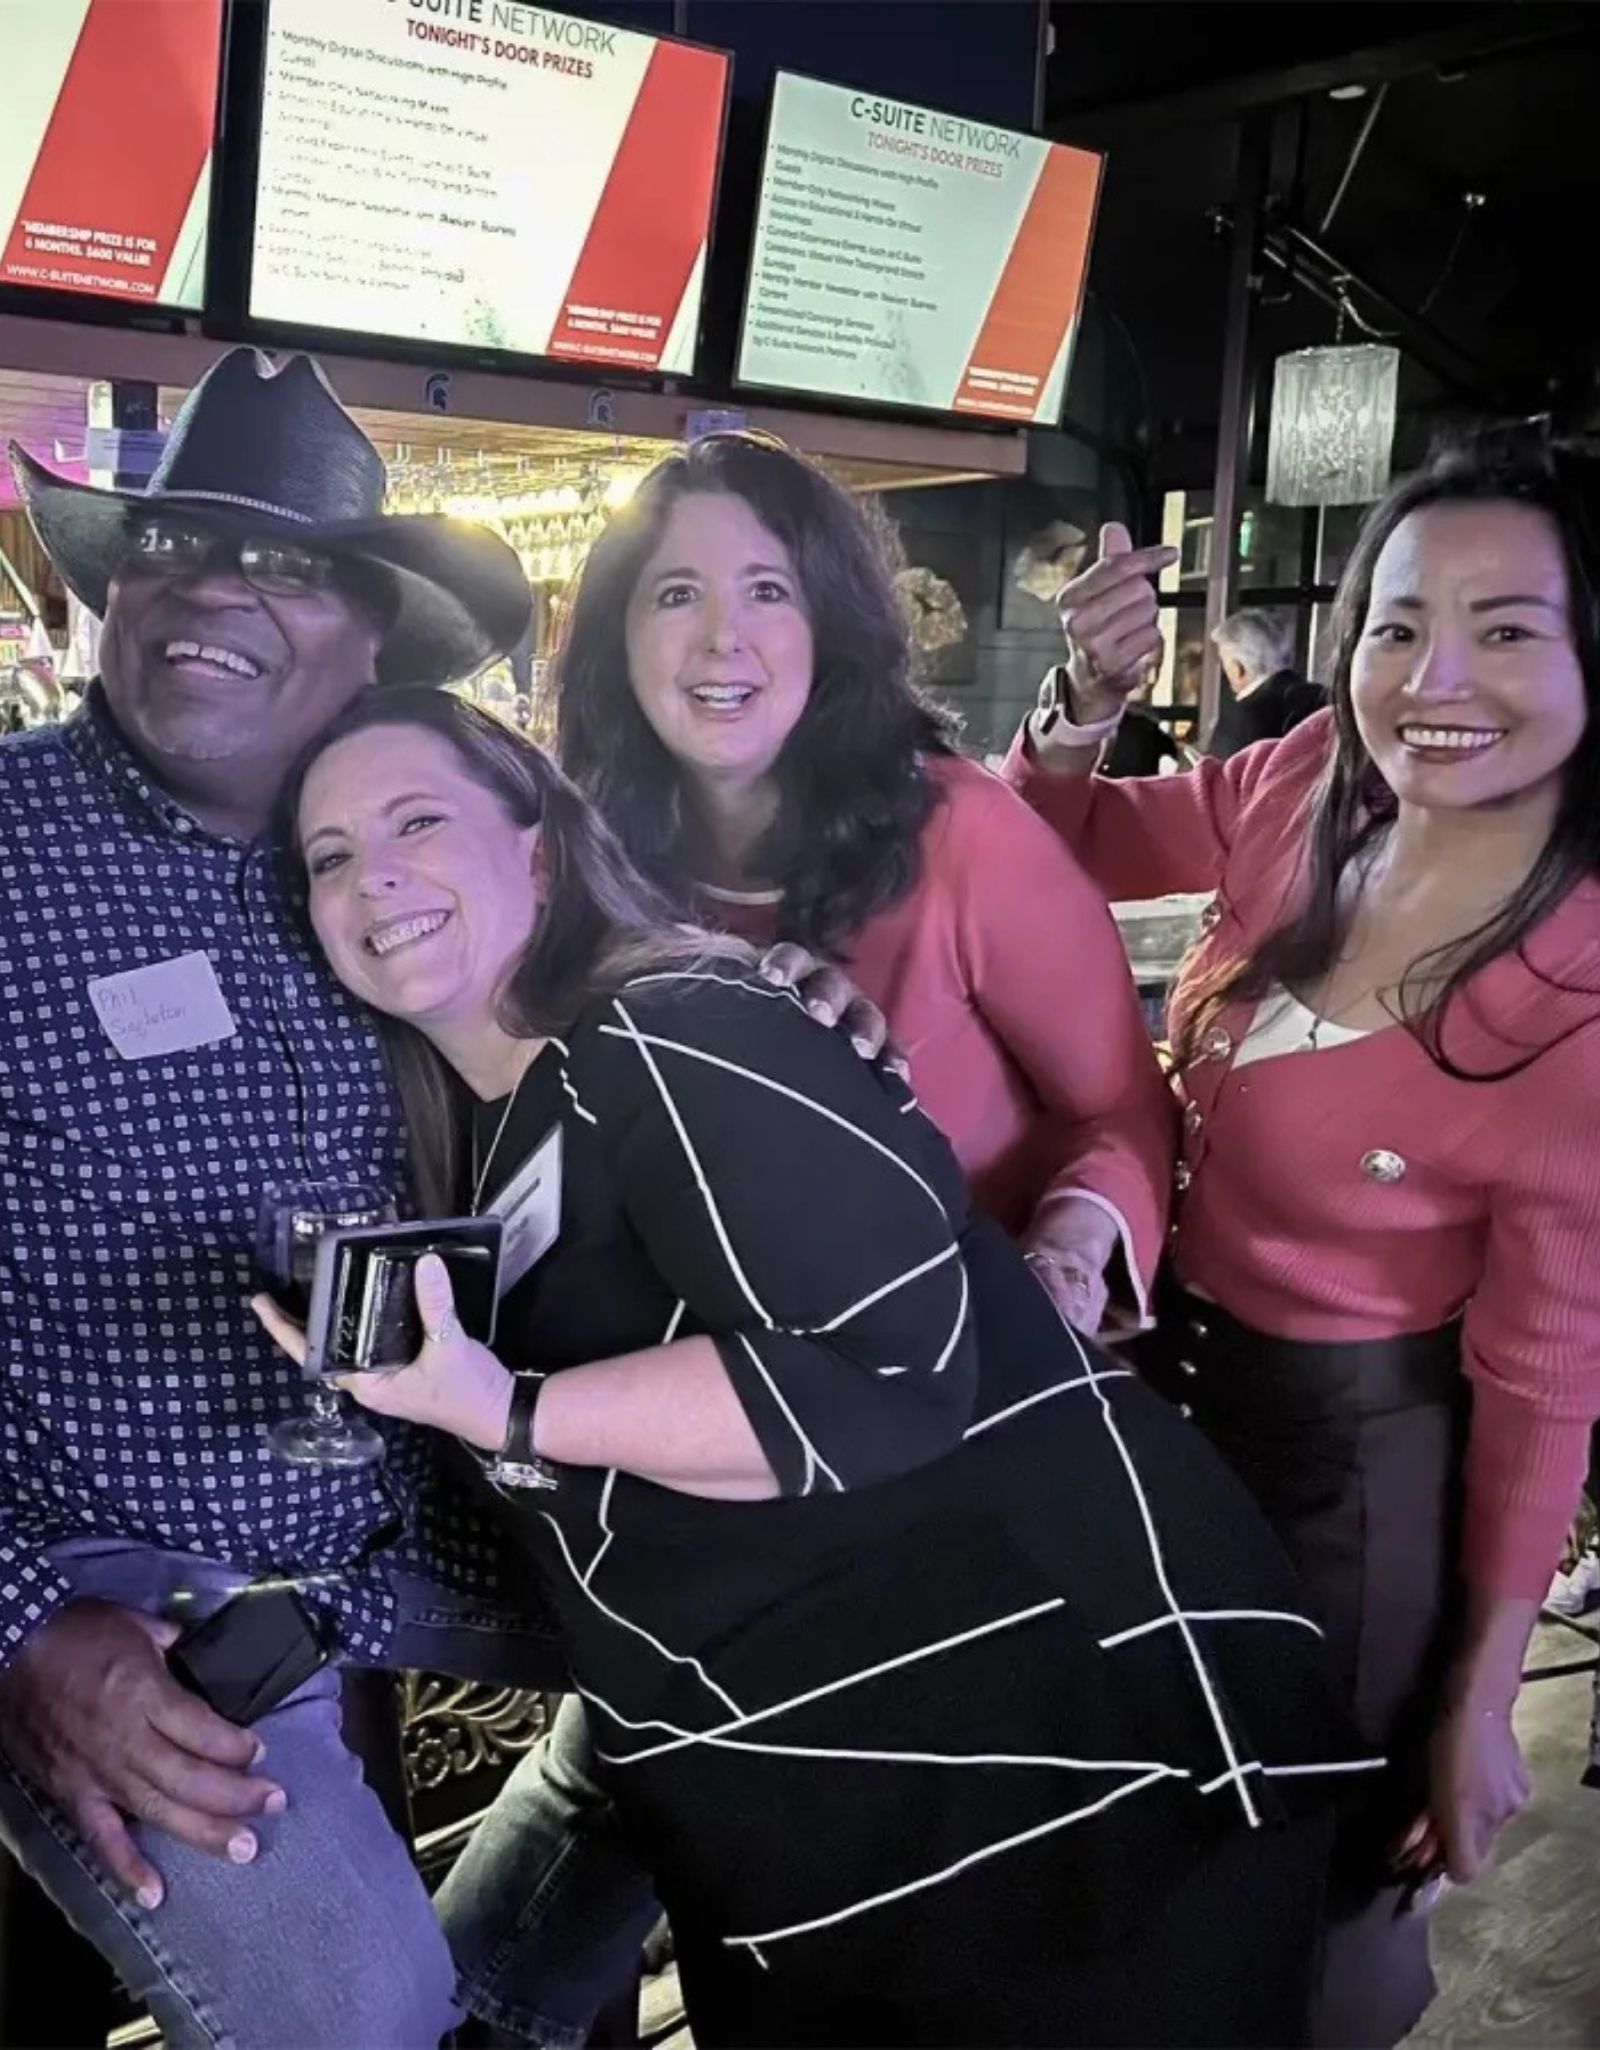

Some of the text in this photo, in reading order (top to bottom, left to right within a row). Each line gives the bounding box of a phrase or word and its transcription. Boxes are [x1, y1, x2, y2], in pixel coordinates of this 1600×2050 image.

[406, 18, 593, 79] TONIGHT'S DOOR PRIZES
[491, 3, 616, 57] NETWORK
[851, 97, 1021, 159] C-SUITE NETWORK
[867, 131, 1004, 179] TONIGHT'S DOOR PRIZES
[93, 230, 122, 248] PRIZE
[136, 237, 156, 251] FOR
[114, 250, 150, 267] VALUE
[97, 984, 137, 1012] Phil
